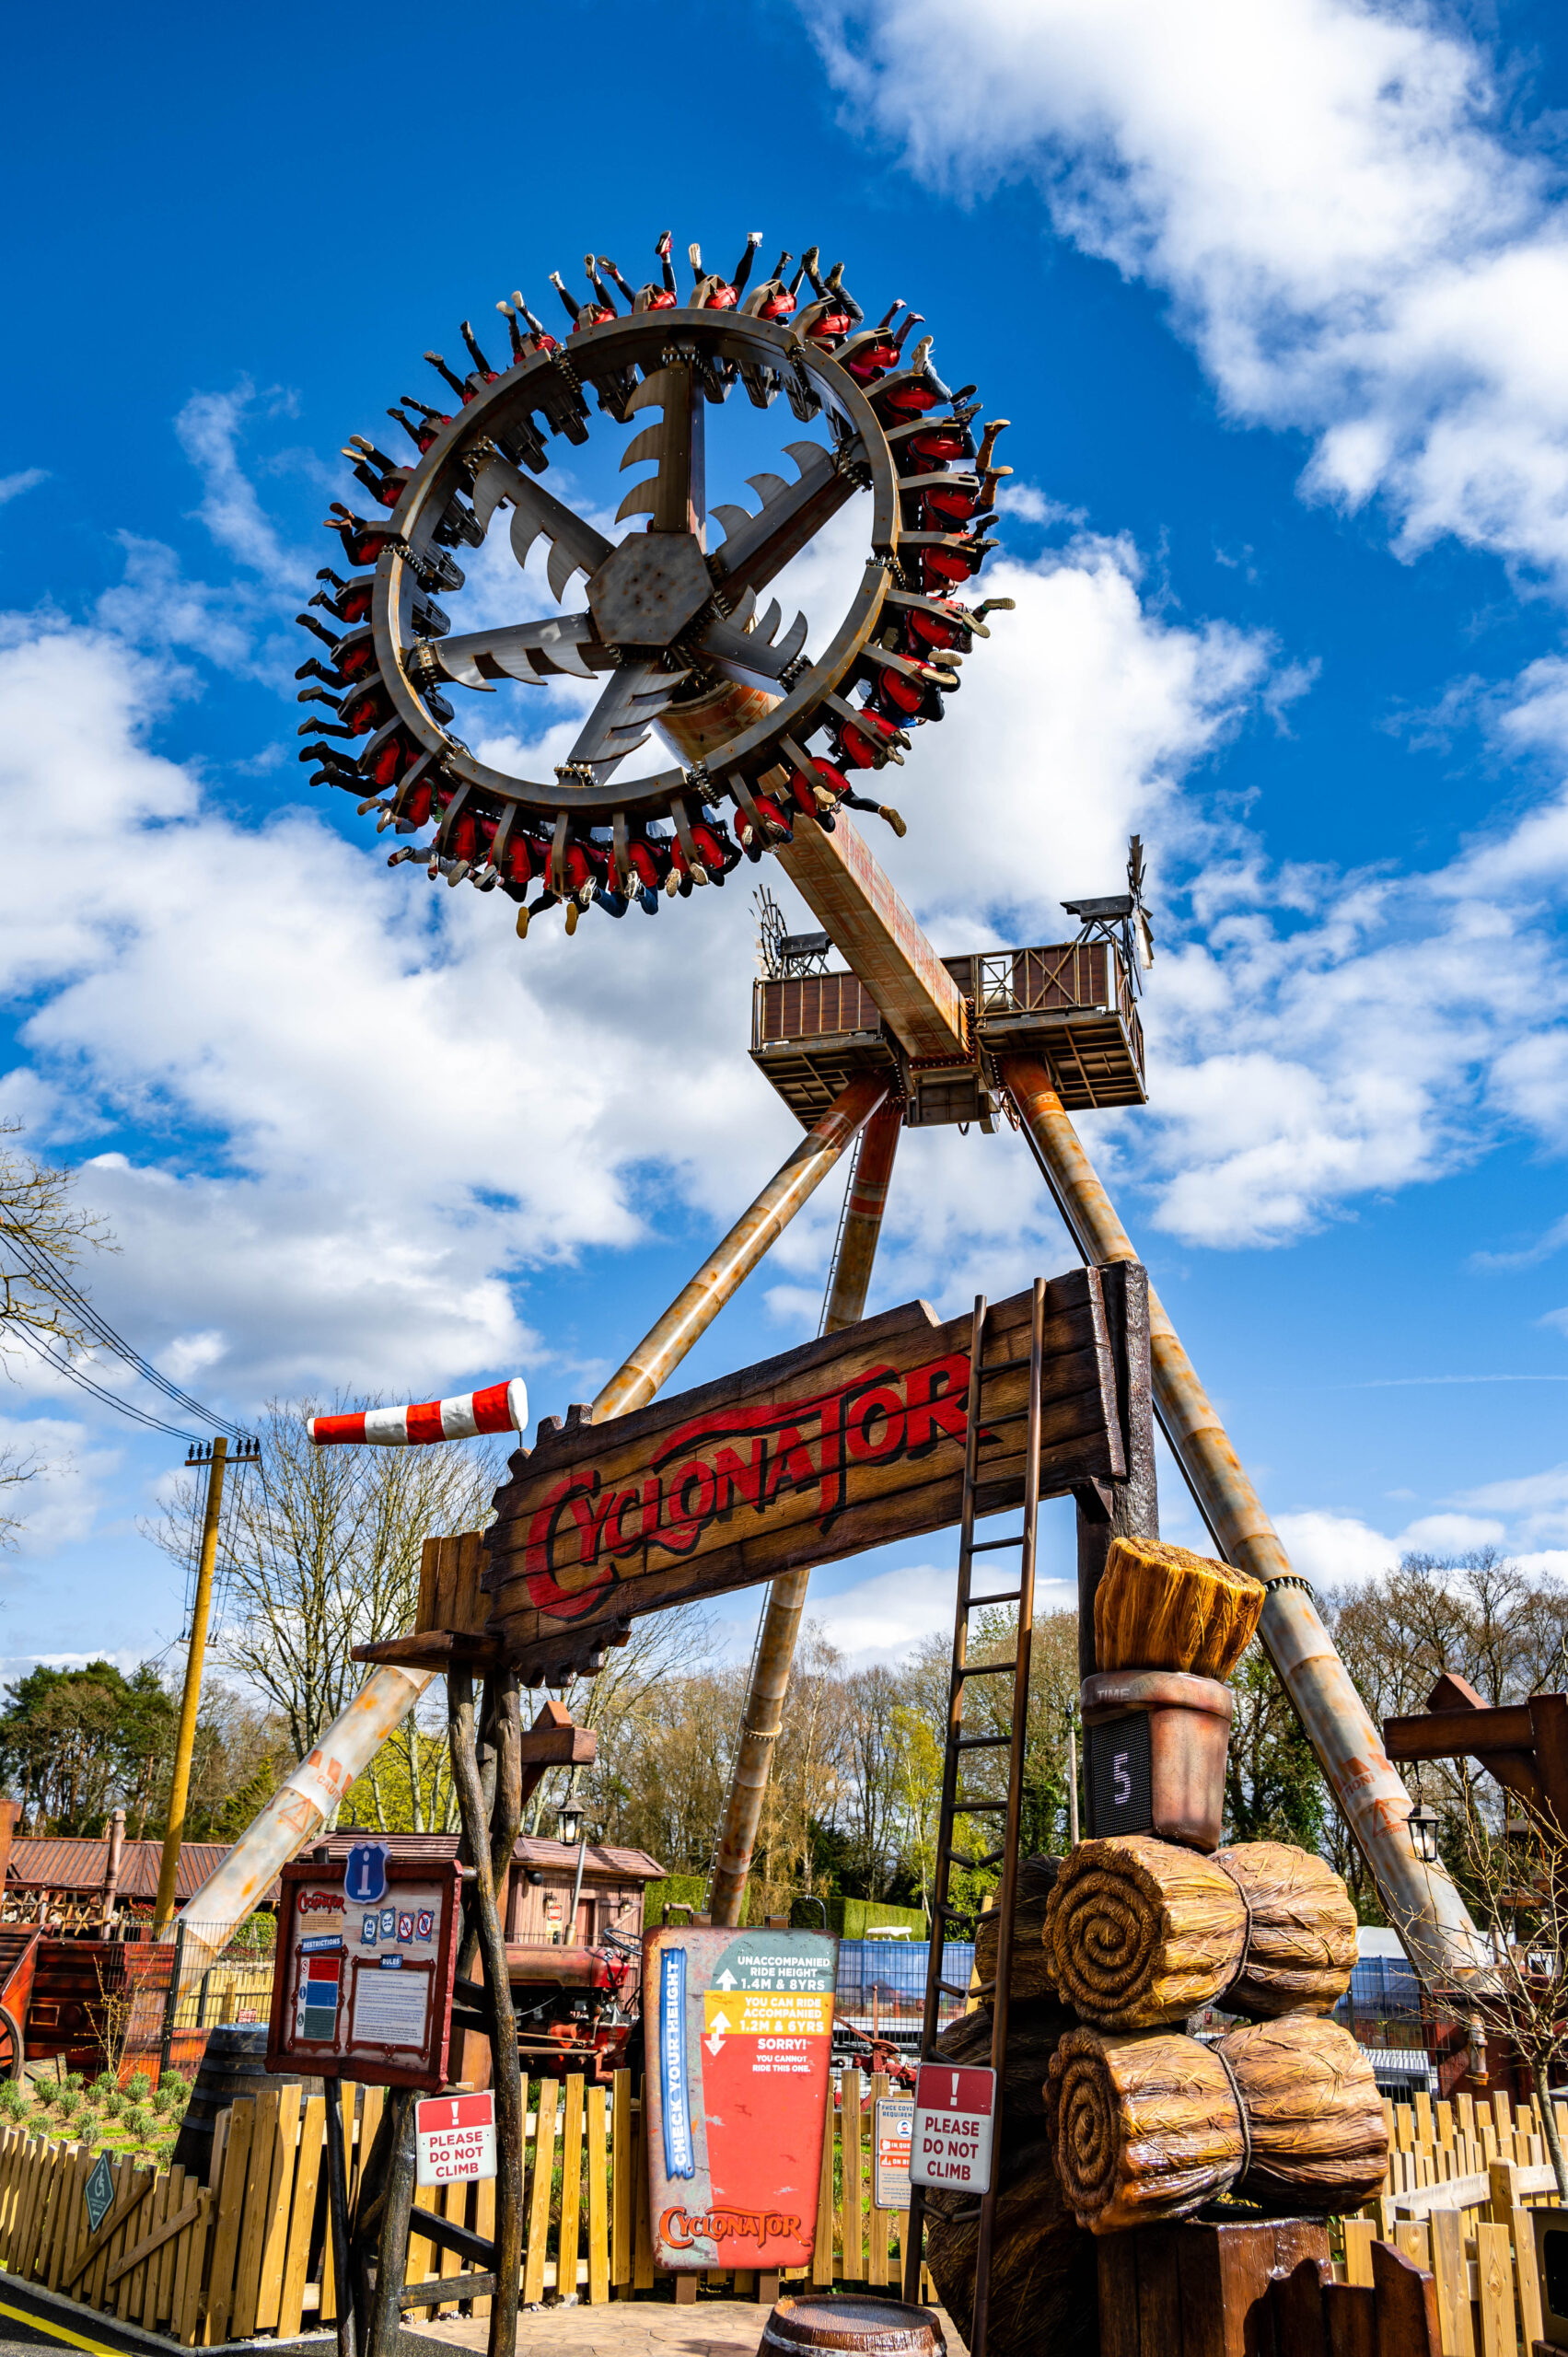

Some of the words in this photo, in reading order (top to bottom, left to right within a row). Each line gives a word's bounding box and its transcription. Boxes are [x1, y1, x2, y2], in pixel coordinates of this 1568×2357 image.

[525, 1353, 1002, 1622] CYCLONATOR
[1097, 1688, 1130, 1701] TIME
[1113, 1752, 1131, 1805] 5
[298, 1890, 347, 1914] CYCLONATOR
[303, 1938, 341, 1949] RESTRICTIONS
[382, 1957, 400, 1966] RULES
[738, 1956, 830, 1968] UNACCOMPANIED
[750, 1968, 775, 1977] RIDE
[778, 1968, 818, 1978] HEIGHT
[741, 1979, 771, 1990] 1.4M
[776, 1979, 785, 1990] &
[789, 1980, 825, 1991] 8YRS
[667, 1960, 679, 2033] HEIGHT
[745, 1997, 768, 2007] YOU
[771, 1997, 794, 2007] CAN
[796, 1998, 821, 2008] RIDE
[743, 2009, 822, 2018] ACCOMPANIED
[739, 2021, 770, 2032] 1.2M
[774, 2021, 784, 2032] &
[788, 2021, 824, 2032] 6YRS
[758, 2038, 807, 2050] SORRY!
[668, 2037, 682, 2093] YOUR
[774, 2055, 807, 2063] CANNOT
[670, 2098, 687, 2166] CHECK
[924, 2116, 980, 2137] PLEASE
[429, 2131, 482, 2148] PLEASE
[429, 2151, 450, 2164] DO
[454, 2146, 484, 2160] NOT
[923, 2138, 944, 2155] DO
[947, 2141, 979, 2159] NOT
[436, 2162, 479, 2177] CLIMB
[927, 2160, 971, 2181] CLIMB
[659, 2204, 811, 2249] CYCLONATOR
